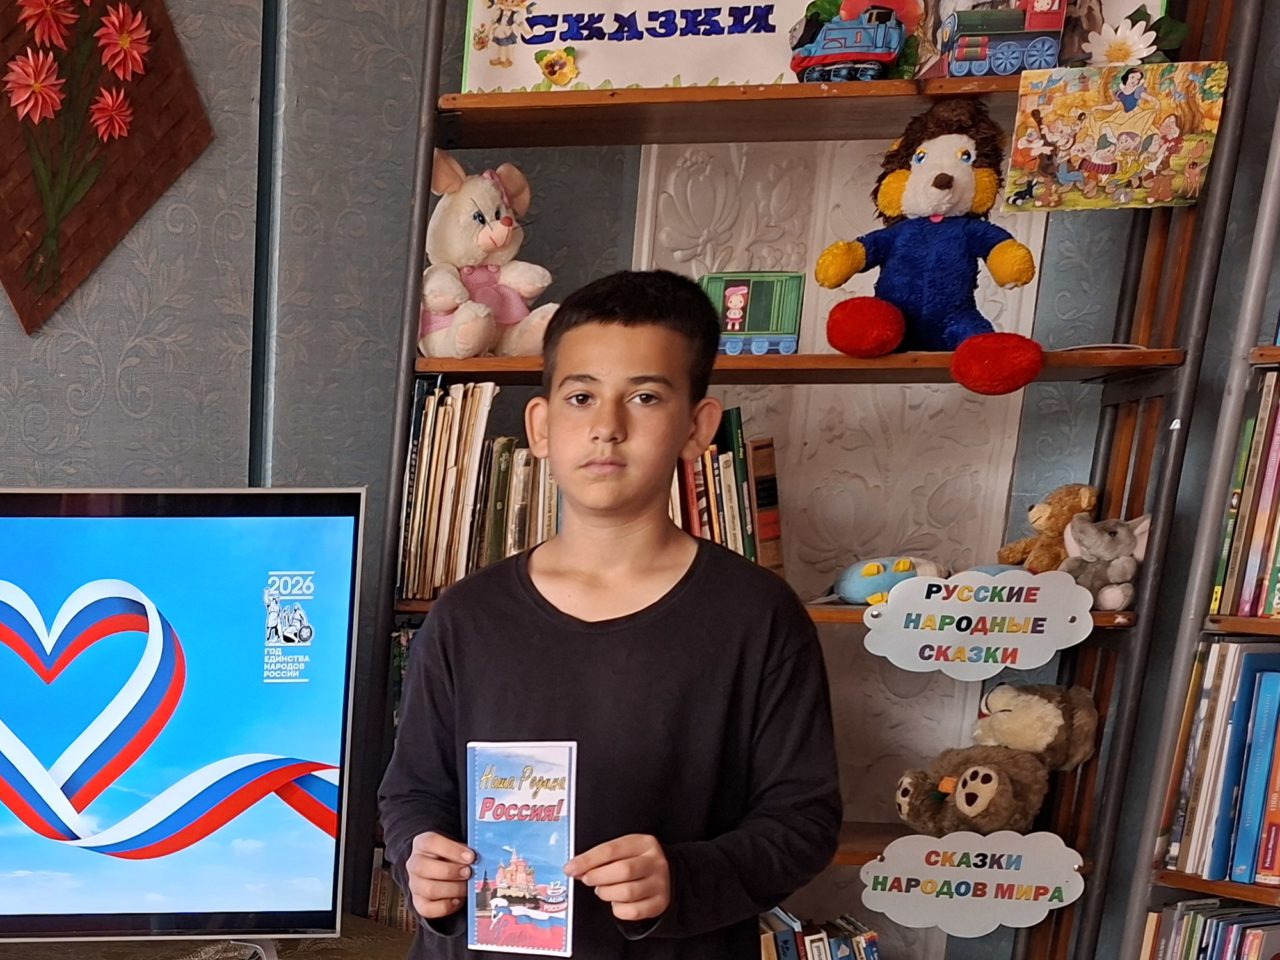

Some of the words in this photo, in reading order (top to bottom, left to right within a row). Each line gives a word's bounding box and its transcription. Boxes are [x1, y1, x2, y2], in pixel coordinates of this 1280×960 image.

[520, 4, 776, 45] СКАЗКИ
[267, 576, 315, 595] 2026
[924, 583, 1040, 603] РУССКИЕ
[903, 612, 1047, 635] НАРОДНЫЕ
[918, 644, 1019, 665] СКАЗКИ
[263, 662, 305, 670] НАРОДОВ
[263, 670, 300, 678] РОССИИ
[479, 764, 515, 791] Наша
[479, 797, 565, 822] Россия!
[924, 850, 1023, 871] СКАЗКИ
[871, 875, 987, 898] НАРОДОВ
[994, 882, 1065, 903] МИРА
